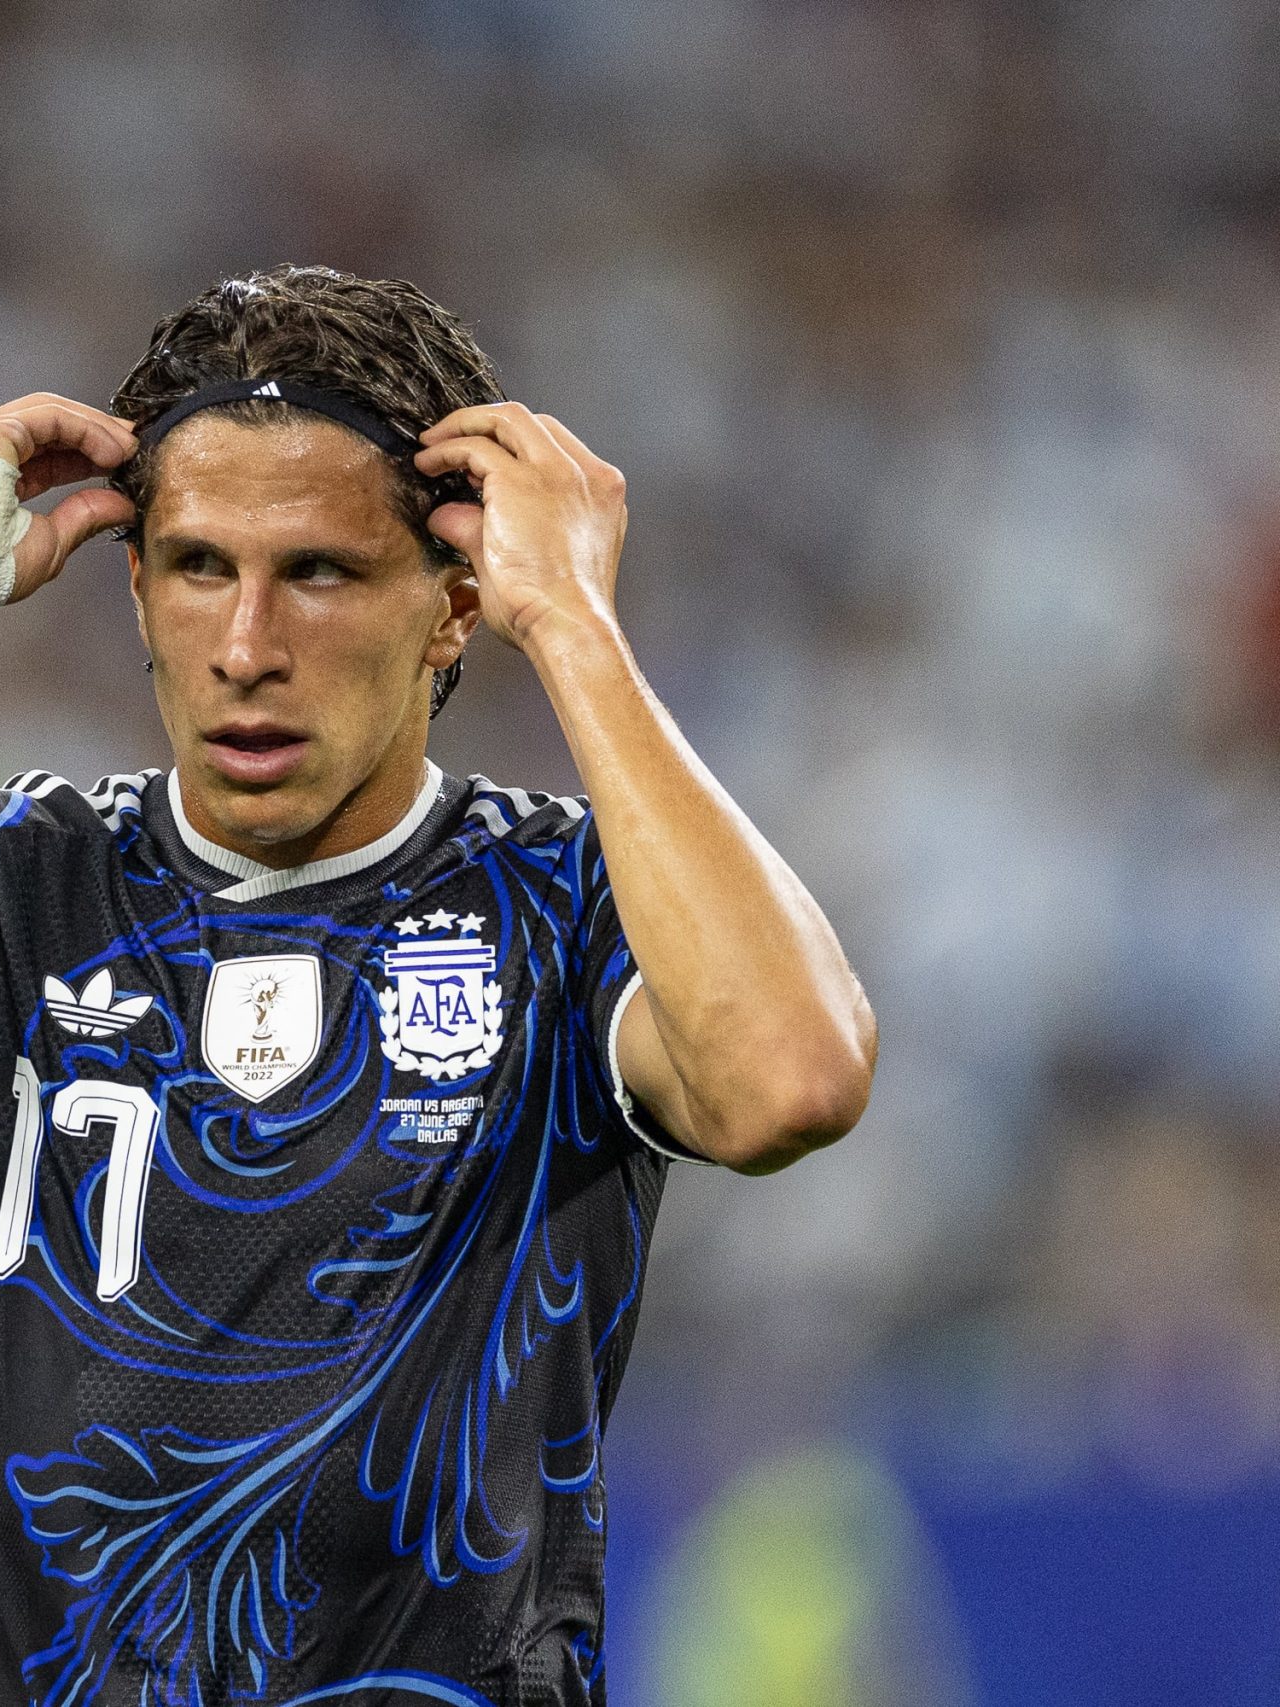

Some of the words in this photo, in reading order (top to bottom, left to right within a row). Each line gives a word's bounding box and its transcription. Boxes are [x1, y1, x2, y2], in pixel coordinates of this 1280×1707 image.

[406, 975, 477, 1036] AFA
[236, 1047, 285, 1063] FIFA
[252, 1062, 297, 1071] CHAMPIONS
[244, 1071, 273, 1081] 2022
[380, 1099, 421, 1112] JORDAN
[424, 1100, 438, 1112] VS
[400, 1114, 415, 1126] 27
[417, 1114, 445, 1128] JUNE
[417, 1129, 458, 1143] DALLAS
